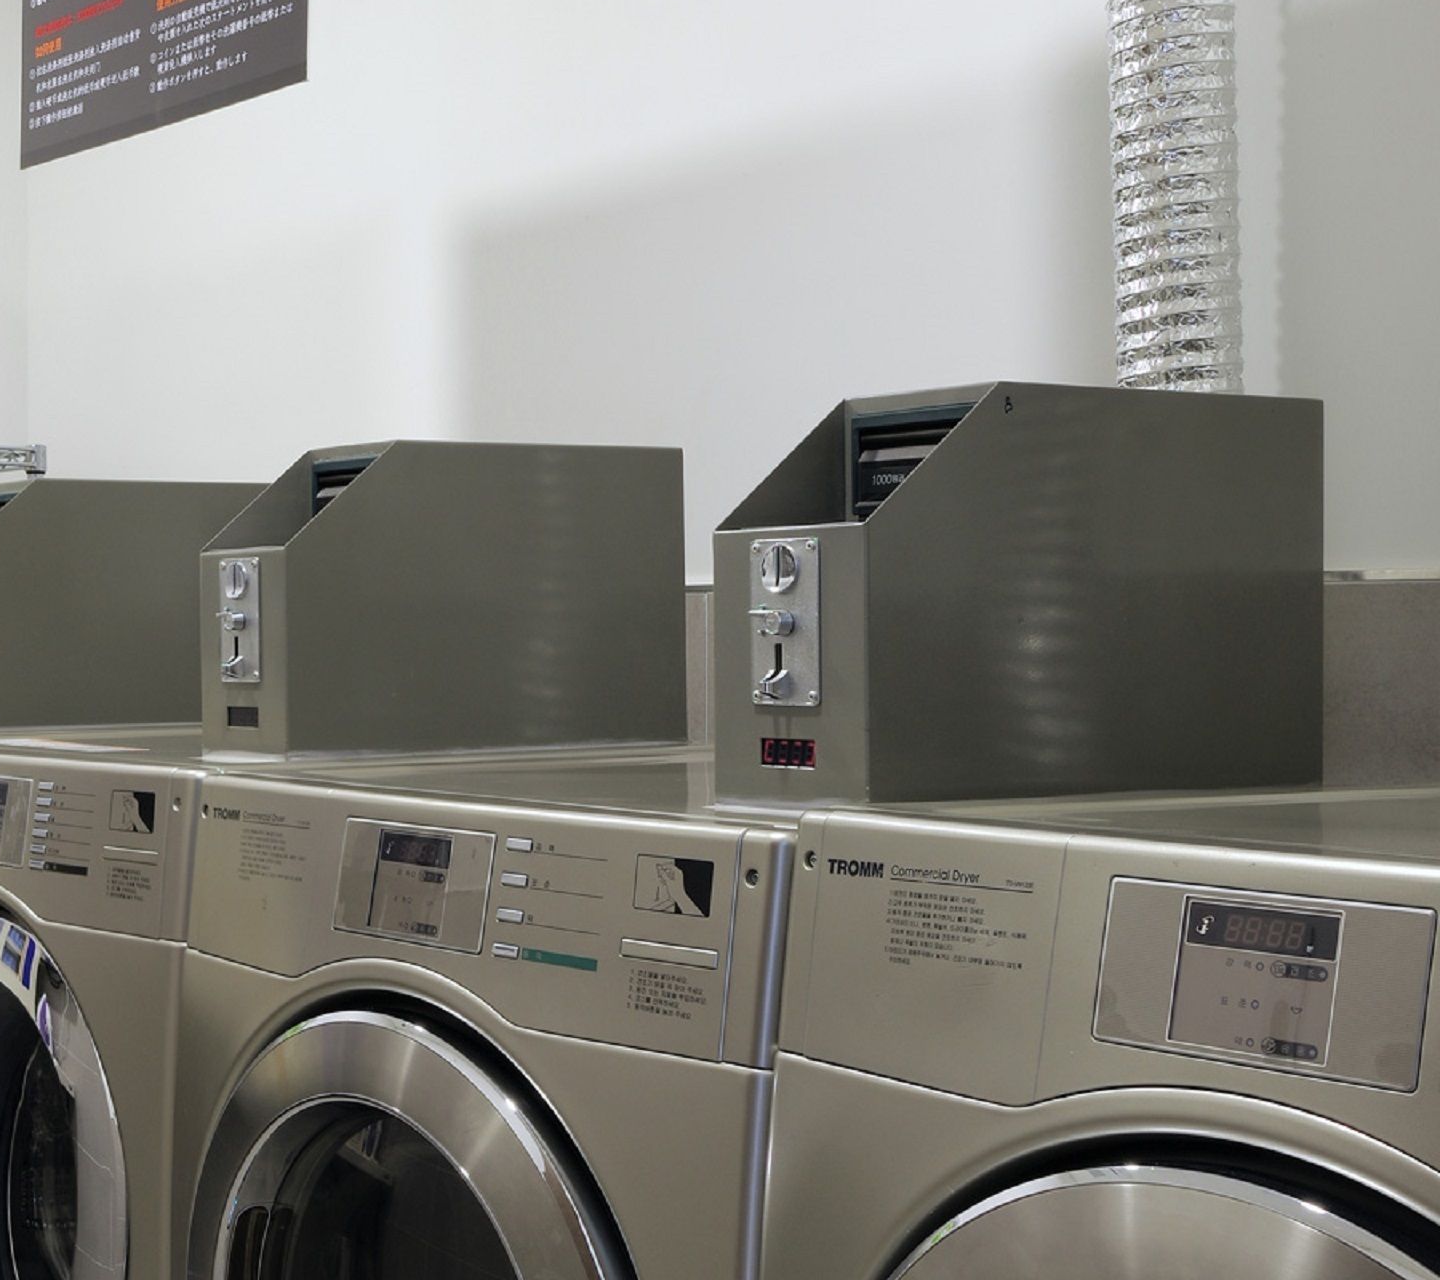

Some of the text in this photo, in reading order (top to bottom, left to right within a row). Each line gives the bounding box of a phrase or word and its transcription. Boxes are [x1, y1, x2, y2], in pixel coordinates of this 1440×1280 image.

[213, 807, 241, 820] TROMM
[827, 858, 980, 884] TROMM Commercial Dryer
